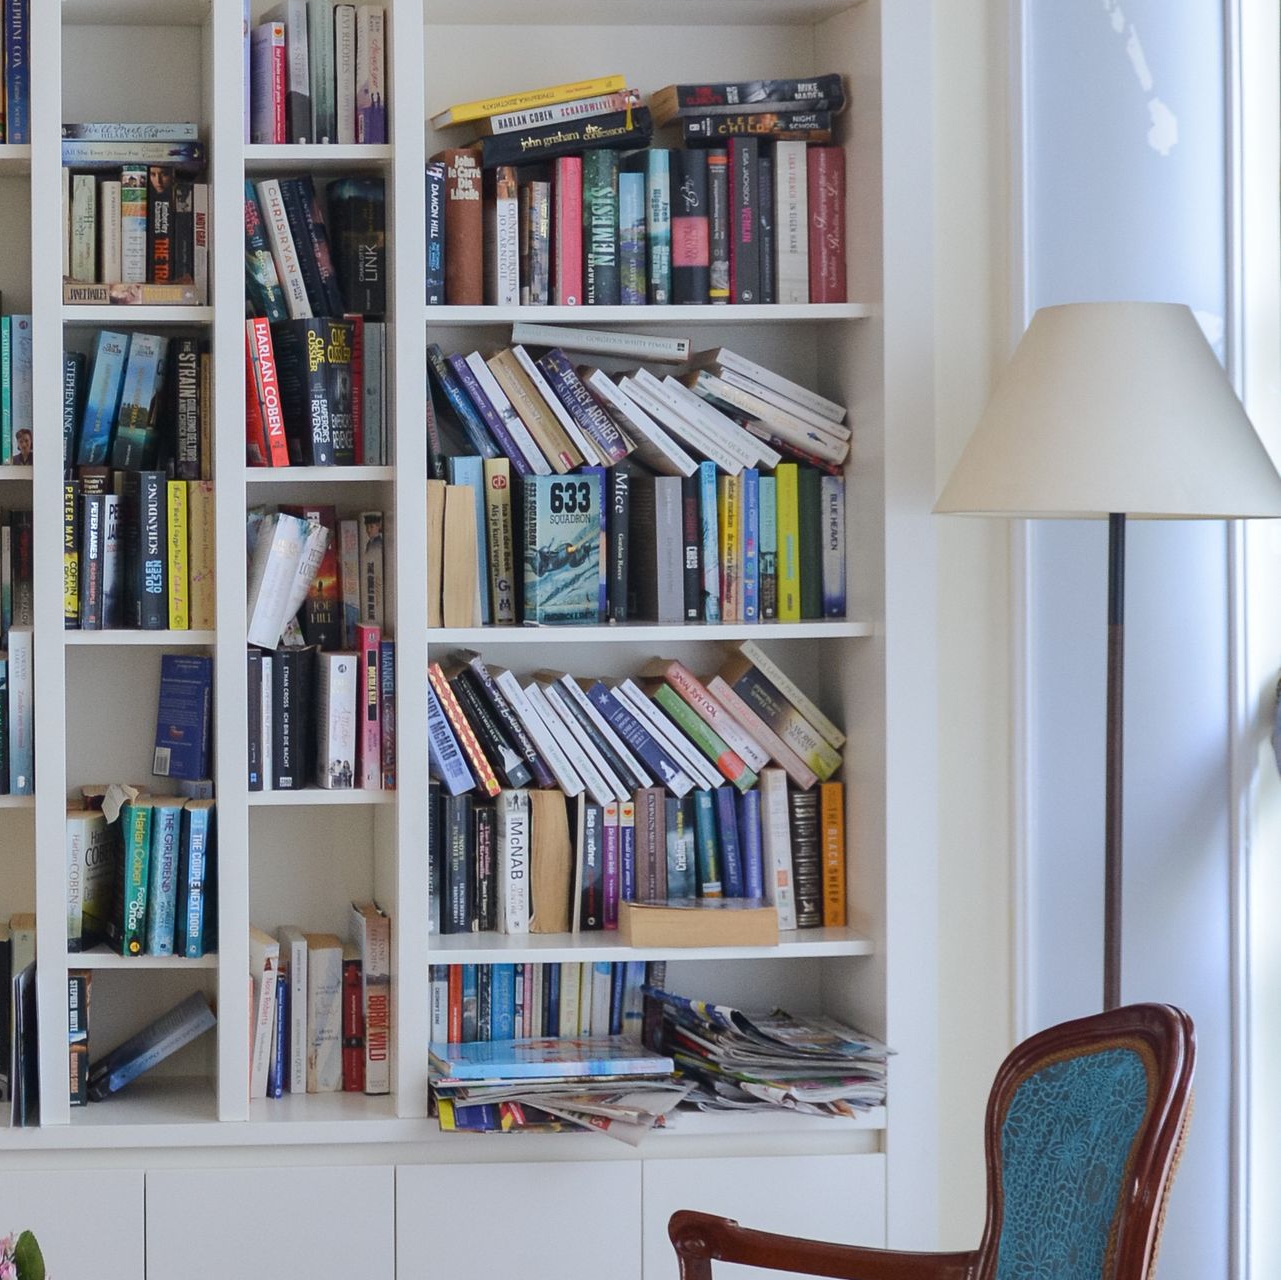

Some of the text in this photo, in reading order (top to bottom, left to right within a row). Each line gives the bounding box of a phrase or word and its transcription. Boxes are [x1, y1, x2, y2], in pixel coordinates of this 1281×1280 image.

[12, 45, 22, 68] COX
[498, 110, 554, 129] HARLAN COBEN
[718, 123, 767, 134] CHILD
[727, 116, 754, 125] LEE
[455, 156, 475, 167] John
[521, 131, 580, 151] john grisham
[458, 178, 472, 188] Die
[268, 187, 296, 273] CHRIS RYAN
[431, 183, 439, 239] DAMON HILL
[592, 187, 615, 267] NEMESIS
[155, 238, 170, 260] THE
[365, 244, 377, 282] LINK
[307, 331, 317, 372] CUSSLER
[316, 338, 325, 363] CLIVE
[178, 353, 197, 397] STRAIN
[255, 324, 282, 436] HARLAN COBEN
[64, 361, 76, 432] STEPHEN KING
[559, 368, 619, 443] JEFFREY ARCHER
[312, 400, 323, 443] REVENGE
[550, 482, 591, 514] 633
[615, 472, 629, 514] Mice
[65, 486, 73, 548] PETER MAY
[90, 502, 99, 560] PETER JAMES
[550, 514, 591, 524] SQUADRON
[146, 560, 155, 593] ADLER
[154, 560, 162, 593] OLSEN
[382, 651, 393, 699] MANKELL
[431, 721, 457, 760] McNAB
[132, 812, 146, 885] Harlan Coben
[162, 814, 174, 893] THE GIRLFRIEND
[511, 821, 523, 879] McNAB
[827, 828, 837, 865] BLACK
[190, 835, 202, 937] THE DOOR
[368, 995, 387, 1061] BORN WILD
